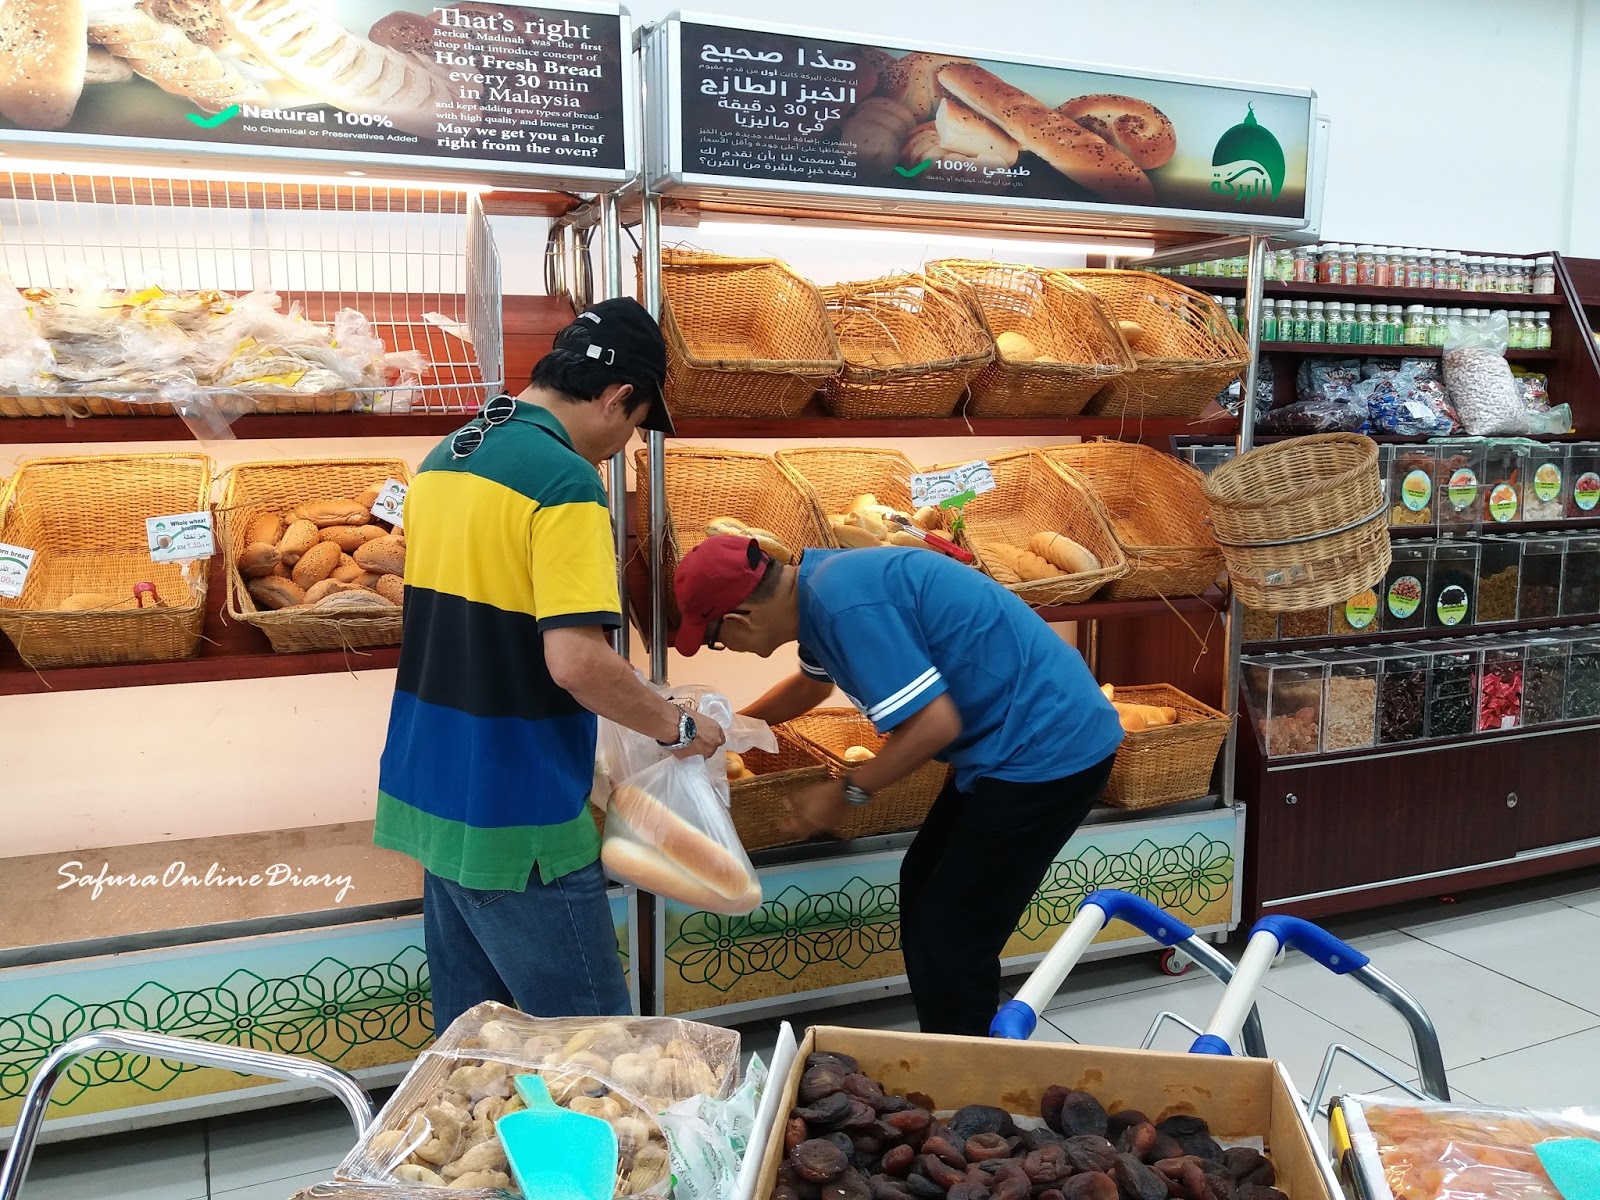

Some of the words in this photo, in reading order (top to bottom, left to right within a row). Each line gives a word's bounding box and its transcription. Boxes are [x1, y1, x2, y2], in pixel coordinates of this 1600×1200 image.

[433, 7, 514, 32] That's
[524, 18, 591, 41] right
[433, 28, 470, 39] Berkat
[476, 32, 525, 44] Madinah
[557, 40, 574, 49] the
[580, 42, 602, 51] first
[433, 40, 460, 51] shop
[463, 42, 484, 51] that
[488, 44, 540, 56] introduce
[543, 50, 584, 61] concept
[586, 53, 598, 62] of
[700, 43, 784, 63] صحيح
[798, 47, 857, 72] هذا
[435, 51, 481, 67] Hot
[482, 55, 538, 72] Fresh
[543, 60, 603, 77] Bread
[448, 71, 508, 89] every
[514, 74, 541, 88] 30
[547, 80, 589, 92] min
[700, 75, 787, 97] الطازج
[459, 85, 480, 99] in
[489, 87, 581, 109] Malaysia
[795, 84, 857, 105] الخبز
[242, 104, 325, 124] Natural
[333, 111, 394, 128] 100%
[435, 101, 454, 109] and
[456, 102, 477, 111] kept
[479, 104, 513, 115] adding
[536, 109, 561, 118] types
[562, 110, 573, 118] of
[784, 103, 807, 116] 30
[814, 107, 841, 121] كل
[436, 112, 458, 120] with
[460, 114, 483, 122] high
[485, 115, 518, 125] quality
[519, 118, 538, 126] and
[540, 119, 569, 129] lowest
[571, 122, 595, 131] price
[734, 112, 790, 129] ماليزيا
[797, 121, 825, 136] في
[260, 126, 306, 135] Chemical
[322, 130, 385, 141] Preservatives
[386, 135, 418, 143] Added
[436, 123, 472, 137] May
[477, 126, 498, 136] we
[501, 128, 525, 141] get
[529, 132, 558, 142] you
[561, 133, 571, 142] a
[574, 132, 605, 144] loaf
[437, 137, 477, 150] right
[481, 140, 522, 151] from
[525, 143, 551, 154] the
[555, 147, 599, 157] oven?
[935, 159, 978, 173] 100%
[982, 165, 1031, 178] طبيعي
[11, 550, 30, 560] bread
